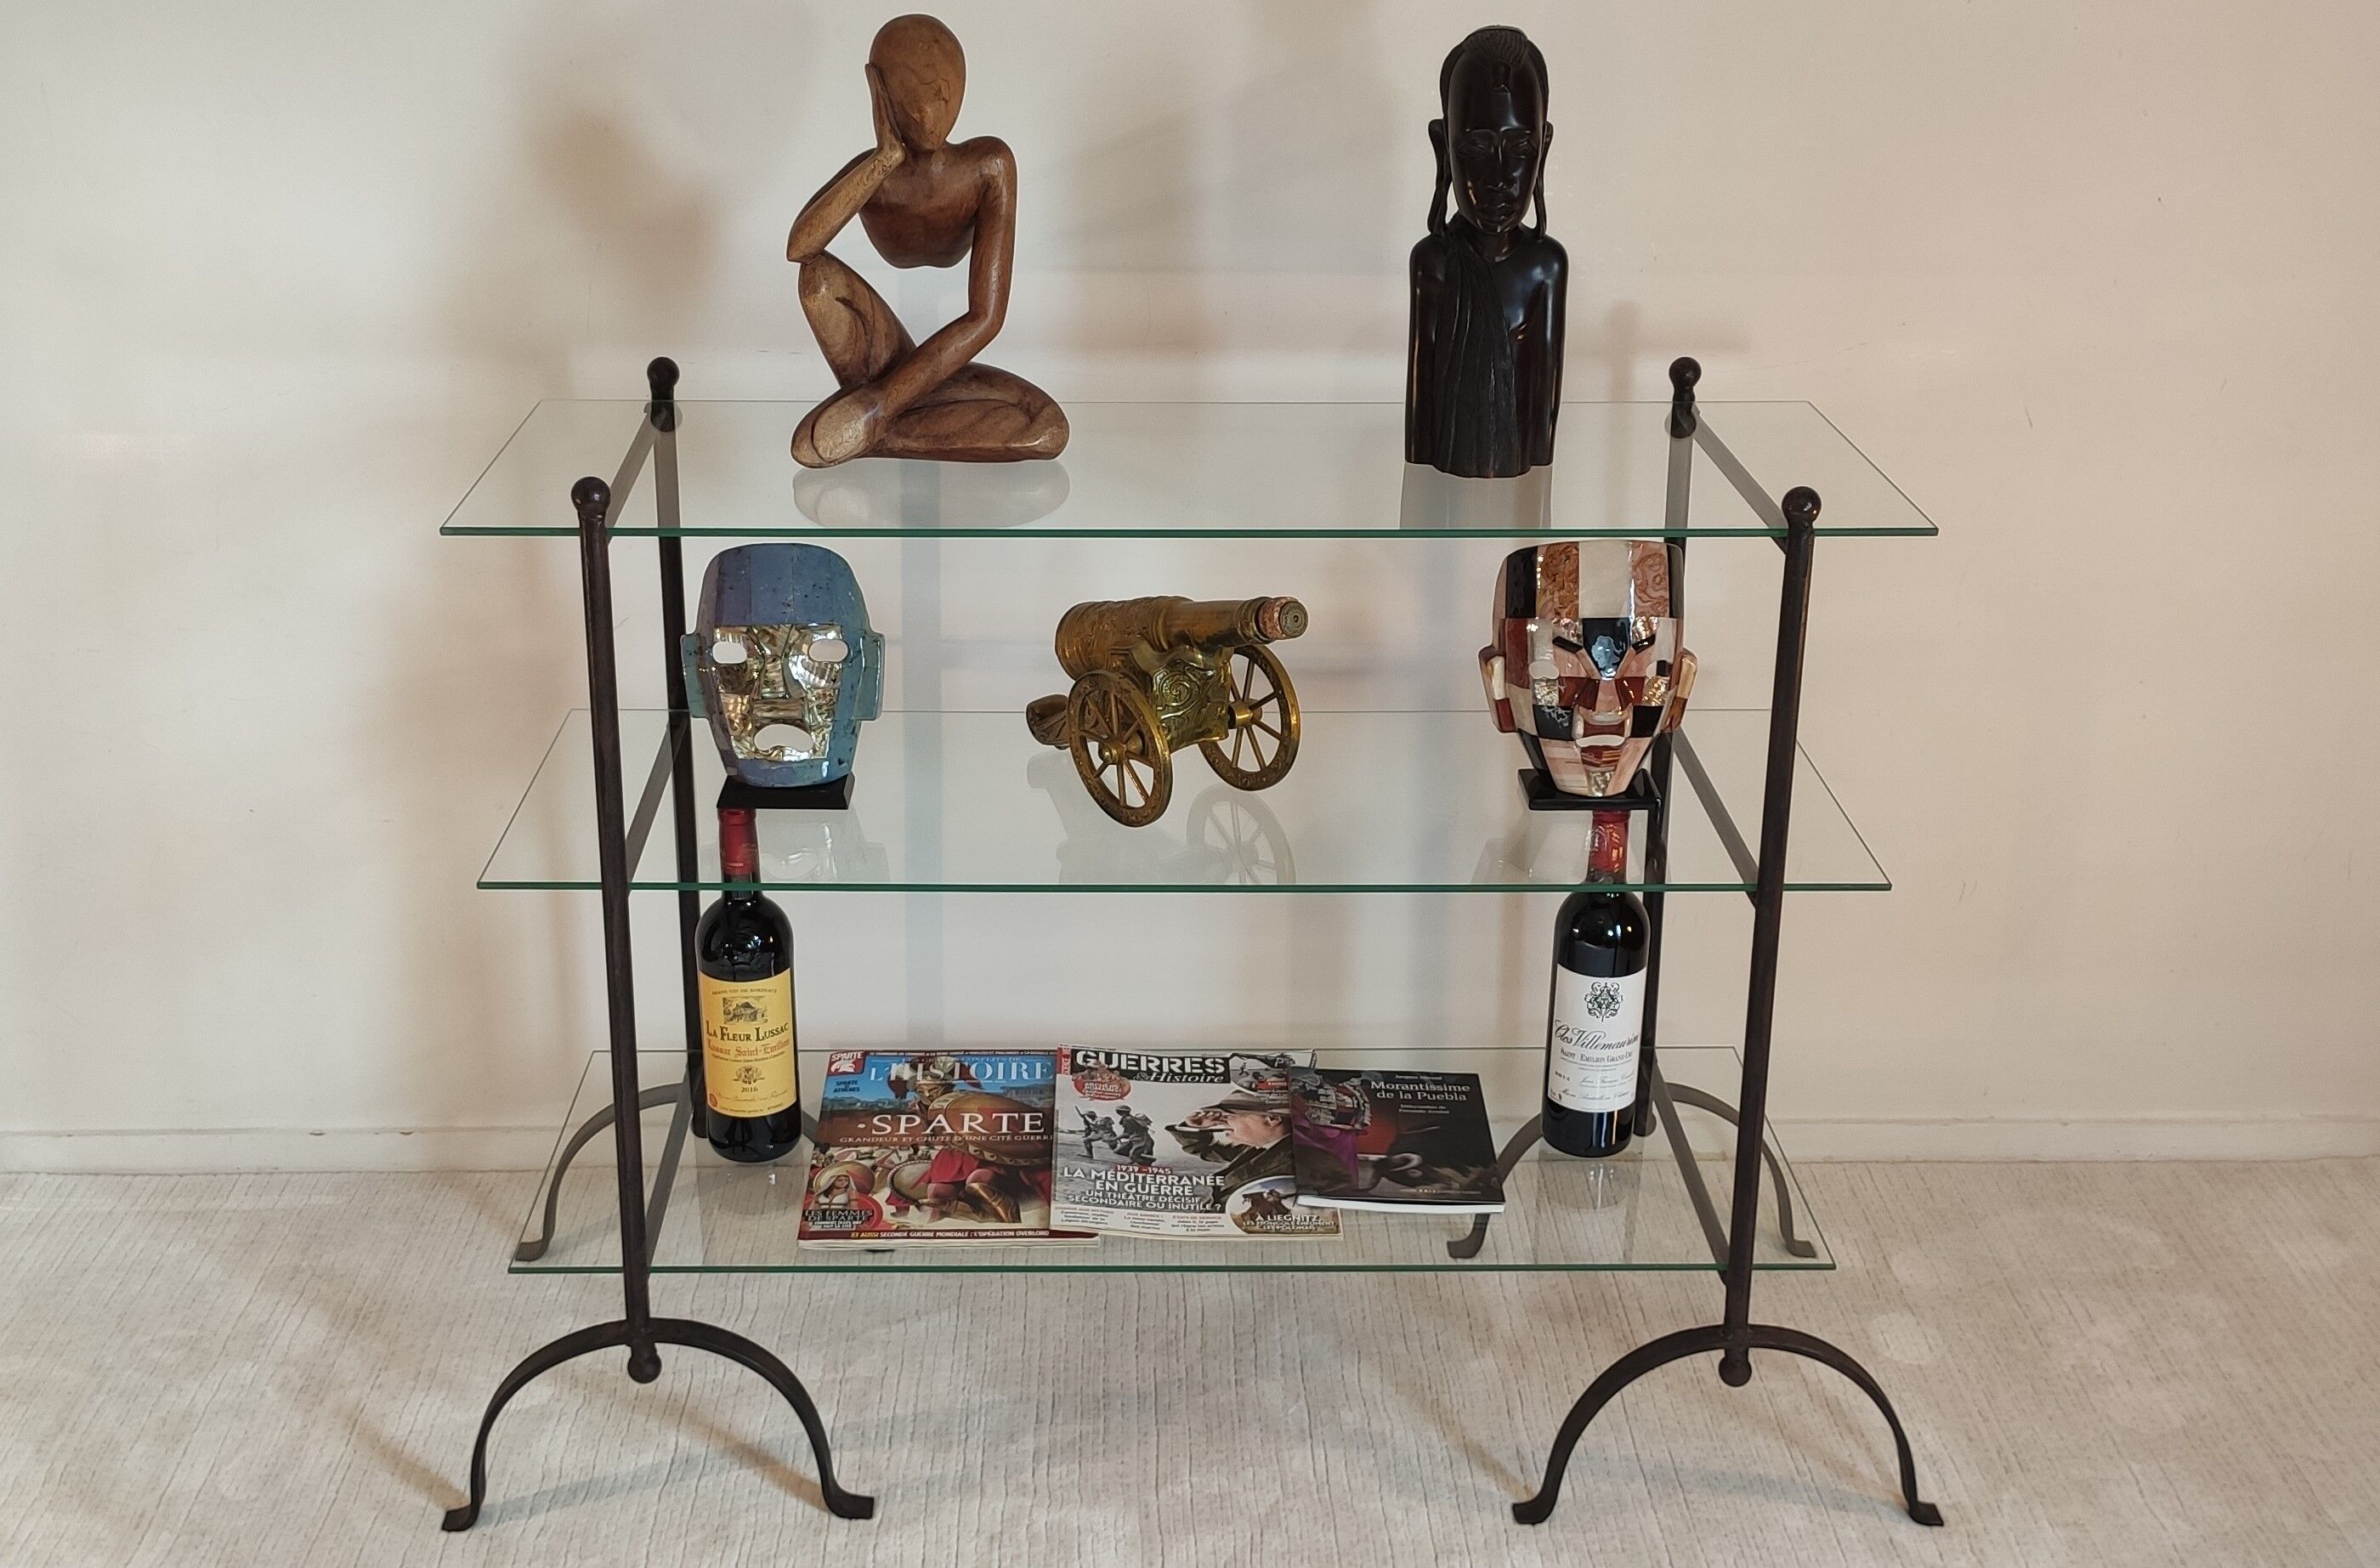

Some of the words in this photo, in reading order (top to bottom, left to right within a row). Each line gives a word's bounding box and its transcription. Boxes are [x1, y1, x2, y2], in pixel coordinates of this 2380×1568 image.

[706, 1019, 717, 1038] LA
[719, 1026, 752, 1041] FLEUR
[755, 1022, 789, 1041] LUSSAC
[1555, 1020, 1572, 1044] Clos
[831, 1051, 863, 1061] SPARTE
[1076, 1050, 1225, 1073] GUERRES
[870, 1061, 1053, 1081] L'HISTOIRE
[1150, 1072, 1224, 1083] Histoire
[1370, 1081, 1470, 1092] Morantissime
[1377, 1090, 1394, 1099] de
[1399, 1090, 1412, 1100] la
[1417, 1091, 1467, 1101] Puebla
[871, 1112, 1045, 1135] SPARTE
[1063, 1167, 1085, 1179] LA
[1091, 1168, 1225, 1186] MÉDITERRANÉE
[1096, 1180, 1119, 1192] EN
[1124, 1183, 1194, 1196] GUERRE
[1068, 1194, 1142, 1208] SECONDAIRE
[1146, 1201, 1165, 1209] OU
[1168, 1202, 1212, 1211] INUTILE
[1214, 1203, 1221, 1211] ?
